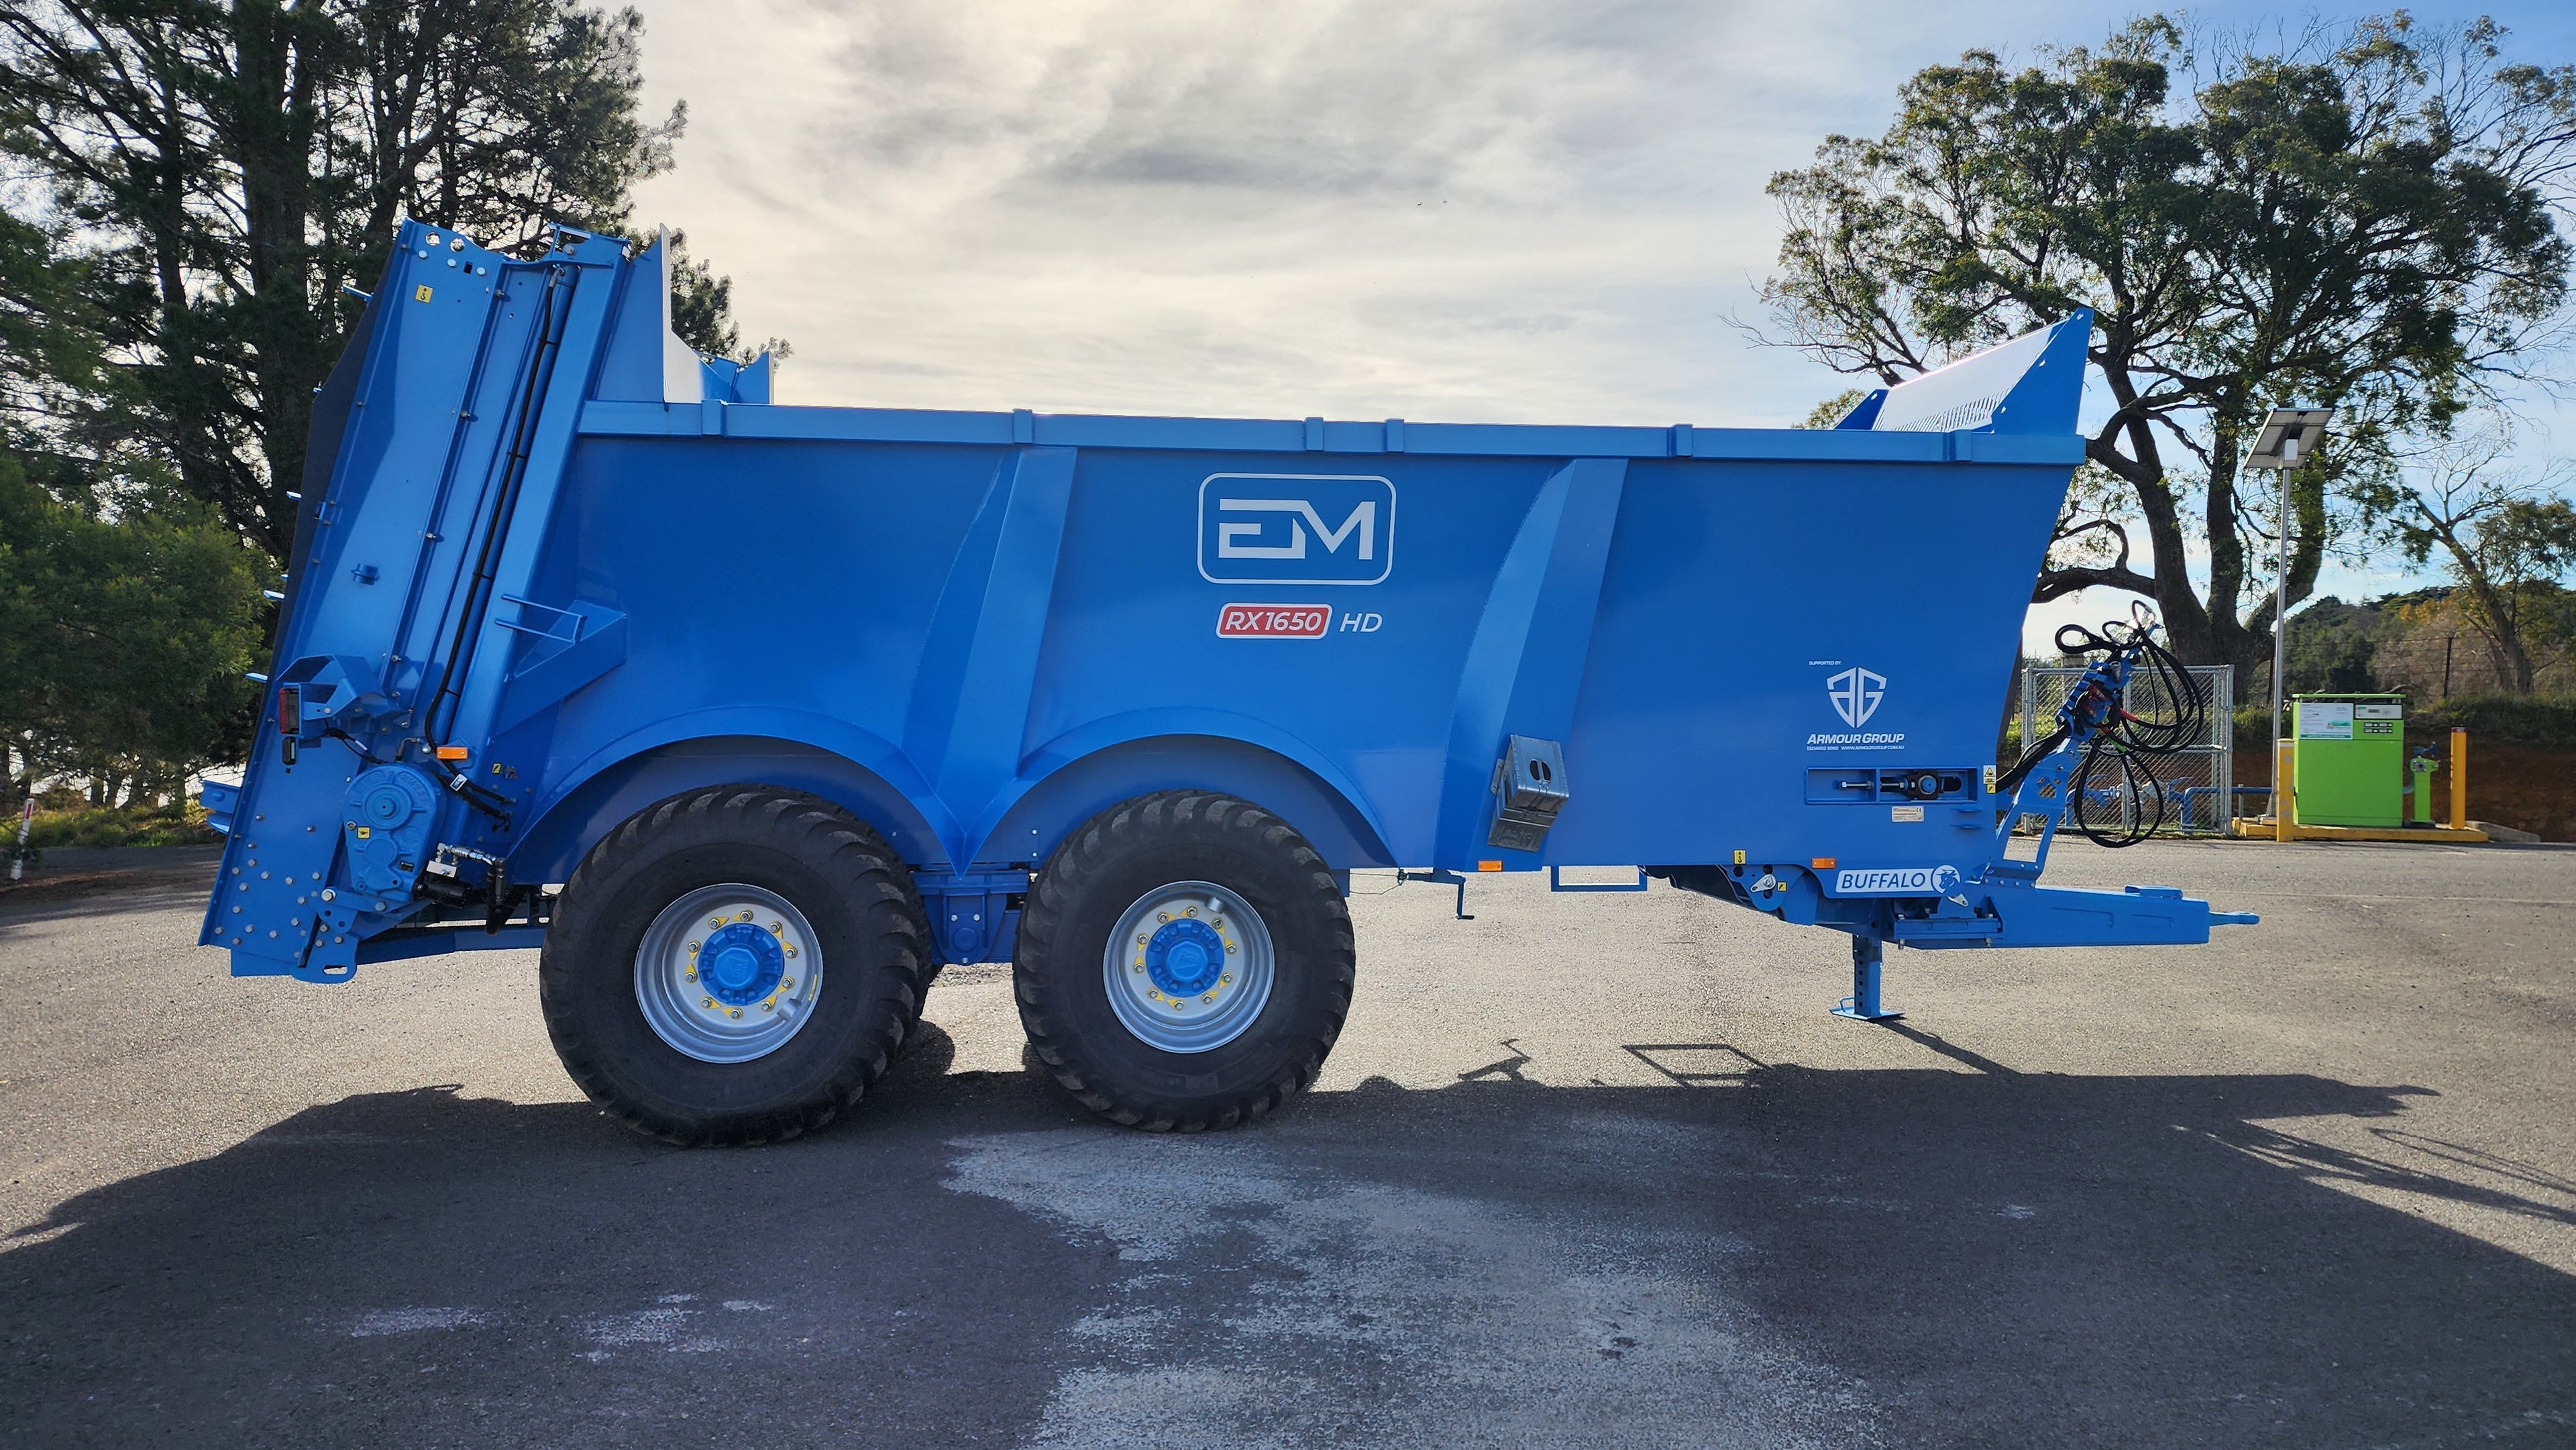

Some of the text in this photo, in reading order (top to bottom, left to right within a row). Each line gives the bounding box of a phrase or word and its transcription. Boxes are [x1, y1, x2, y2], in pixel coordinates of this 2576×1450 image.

[1218, 498, 1376, 560] EM
[1225, 611, 1383, 632] RX1650 HD
[1807, 733, 1905, 744] ARMOUR GROUP
[1841, 873, 1926, 889] BUFFALO
